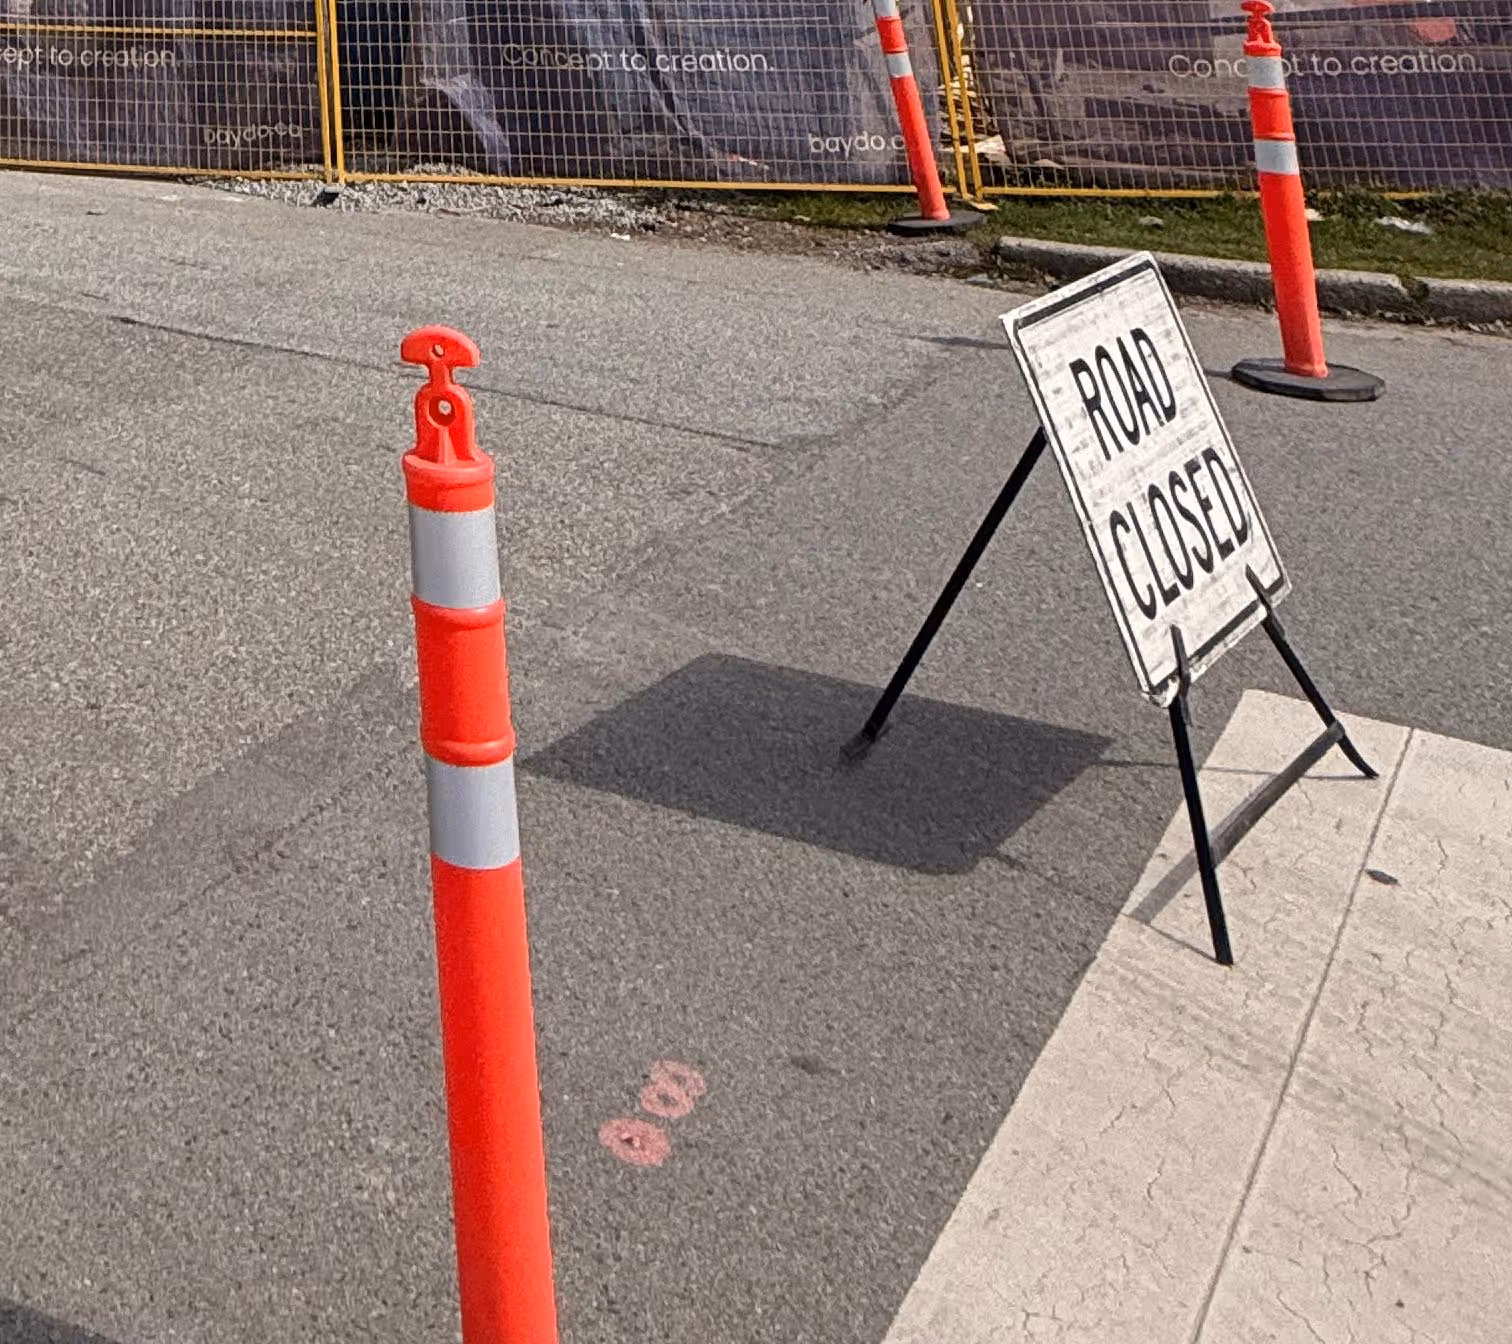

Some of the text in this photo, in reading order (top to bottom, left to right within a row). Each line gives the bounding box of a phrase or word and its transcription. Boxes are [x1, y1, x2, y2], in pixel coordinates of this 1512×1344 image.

[50, 44, 75, 68] to
[502, 43, 776, 73] Concept to creation.
[1313, 52, 1343, 77] to
[1069, 327, 1178, 462] ROAD
[1109, 446, 1254, 621] CLOSED
